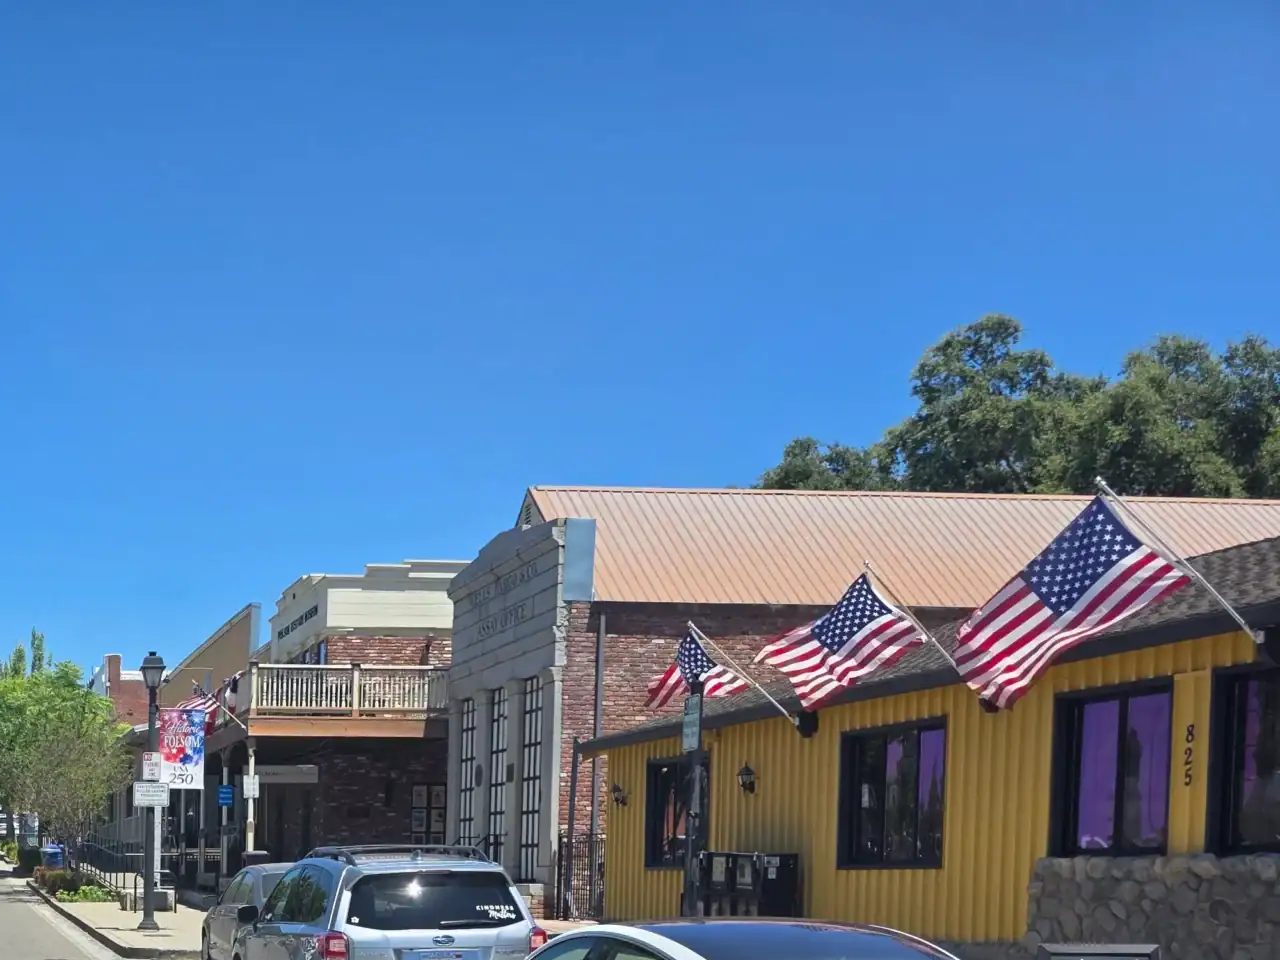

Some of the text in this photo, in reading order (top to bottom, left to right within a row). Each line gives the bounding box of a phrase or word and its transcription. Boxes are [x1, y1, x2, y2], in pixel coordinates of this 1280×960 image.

[165, 720, 200, 733] Historic
[164, 735, 200, 748] FOLSOM
[173, 765, 188, 773] USA
[169, 773, 194, 785] 250
